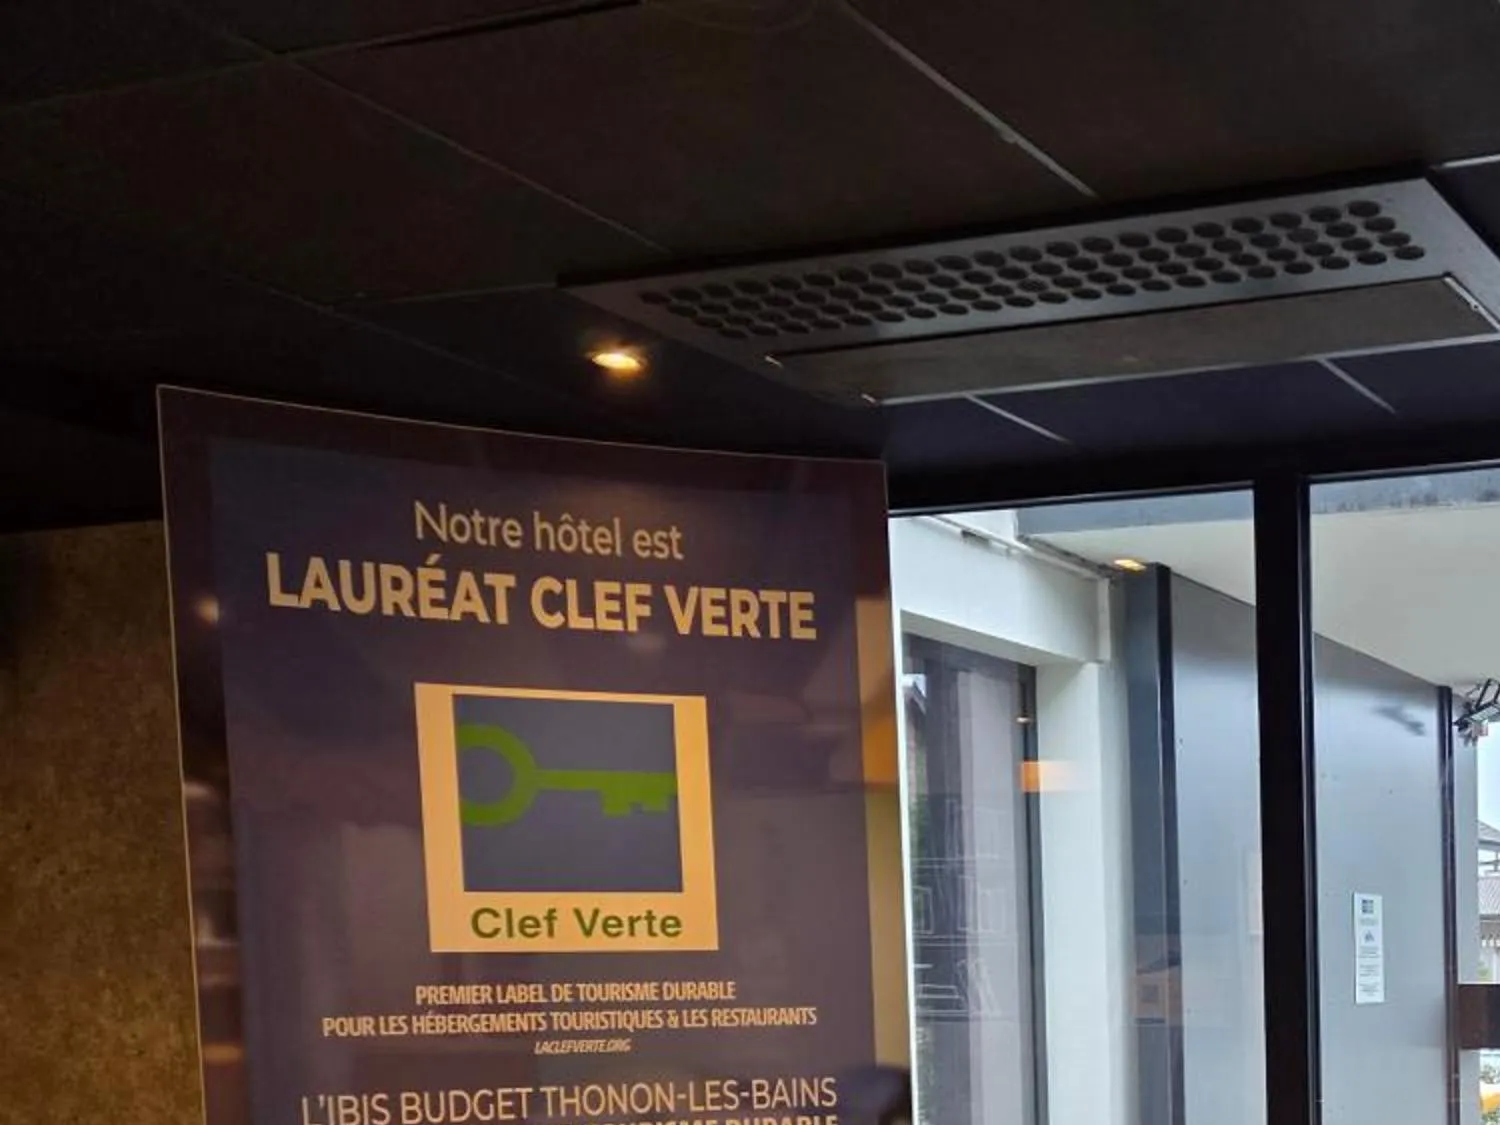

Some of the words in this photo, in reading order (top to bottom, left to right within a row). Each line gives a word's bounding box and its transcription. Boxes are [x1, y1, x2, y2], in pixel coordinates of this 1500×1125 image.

[414, 501, 523, 549] Notre
[533, 512, 622, 557] hôtel
[632, 525, 684, 560] est
[266, 553, 515, 624] LAURÉAT
[531, 577, 652, 632] CLEF
[664, 586, 817, 640] VERTE
[470, 906, 558, 939] Clef
[573, 907, 684, 939] Verte
[415, 985, 491, 1005] PREMIER
[497, 984, 547, 1003] LABEL
[551, 983, 573, 1002] DE
[576, 981, 660, 1001] TOURISME
[662, 981, 737, 1000] DURABLE
[322, 1017, 376, 1038] POUR
[379, 1015, 408, 1036] LES
[412, 1009, 547, 1034] HÉBERGEMENTS
[550, 1009, 664, 1033] TOURISTIQUES
[667, 1009, 679, 1028] &
[682, 1009, 710, 1028] LES
[712, 1007, 818, 1027] RESTAURANTS
[401, 1087, 533, 1125] BUDGET
[540, 1077, 838, 1119] THONON-LES-BAINS
